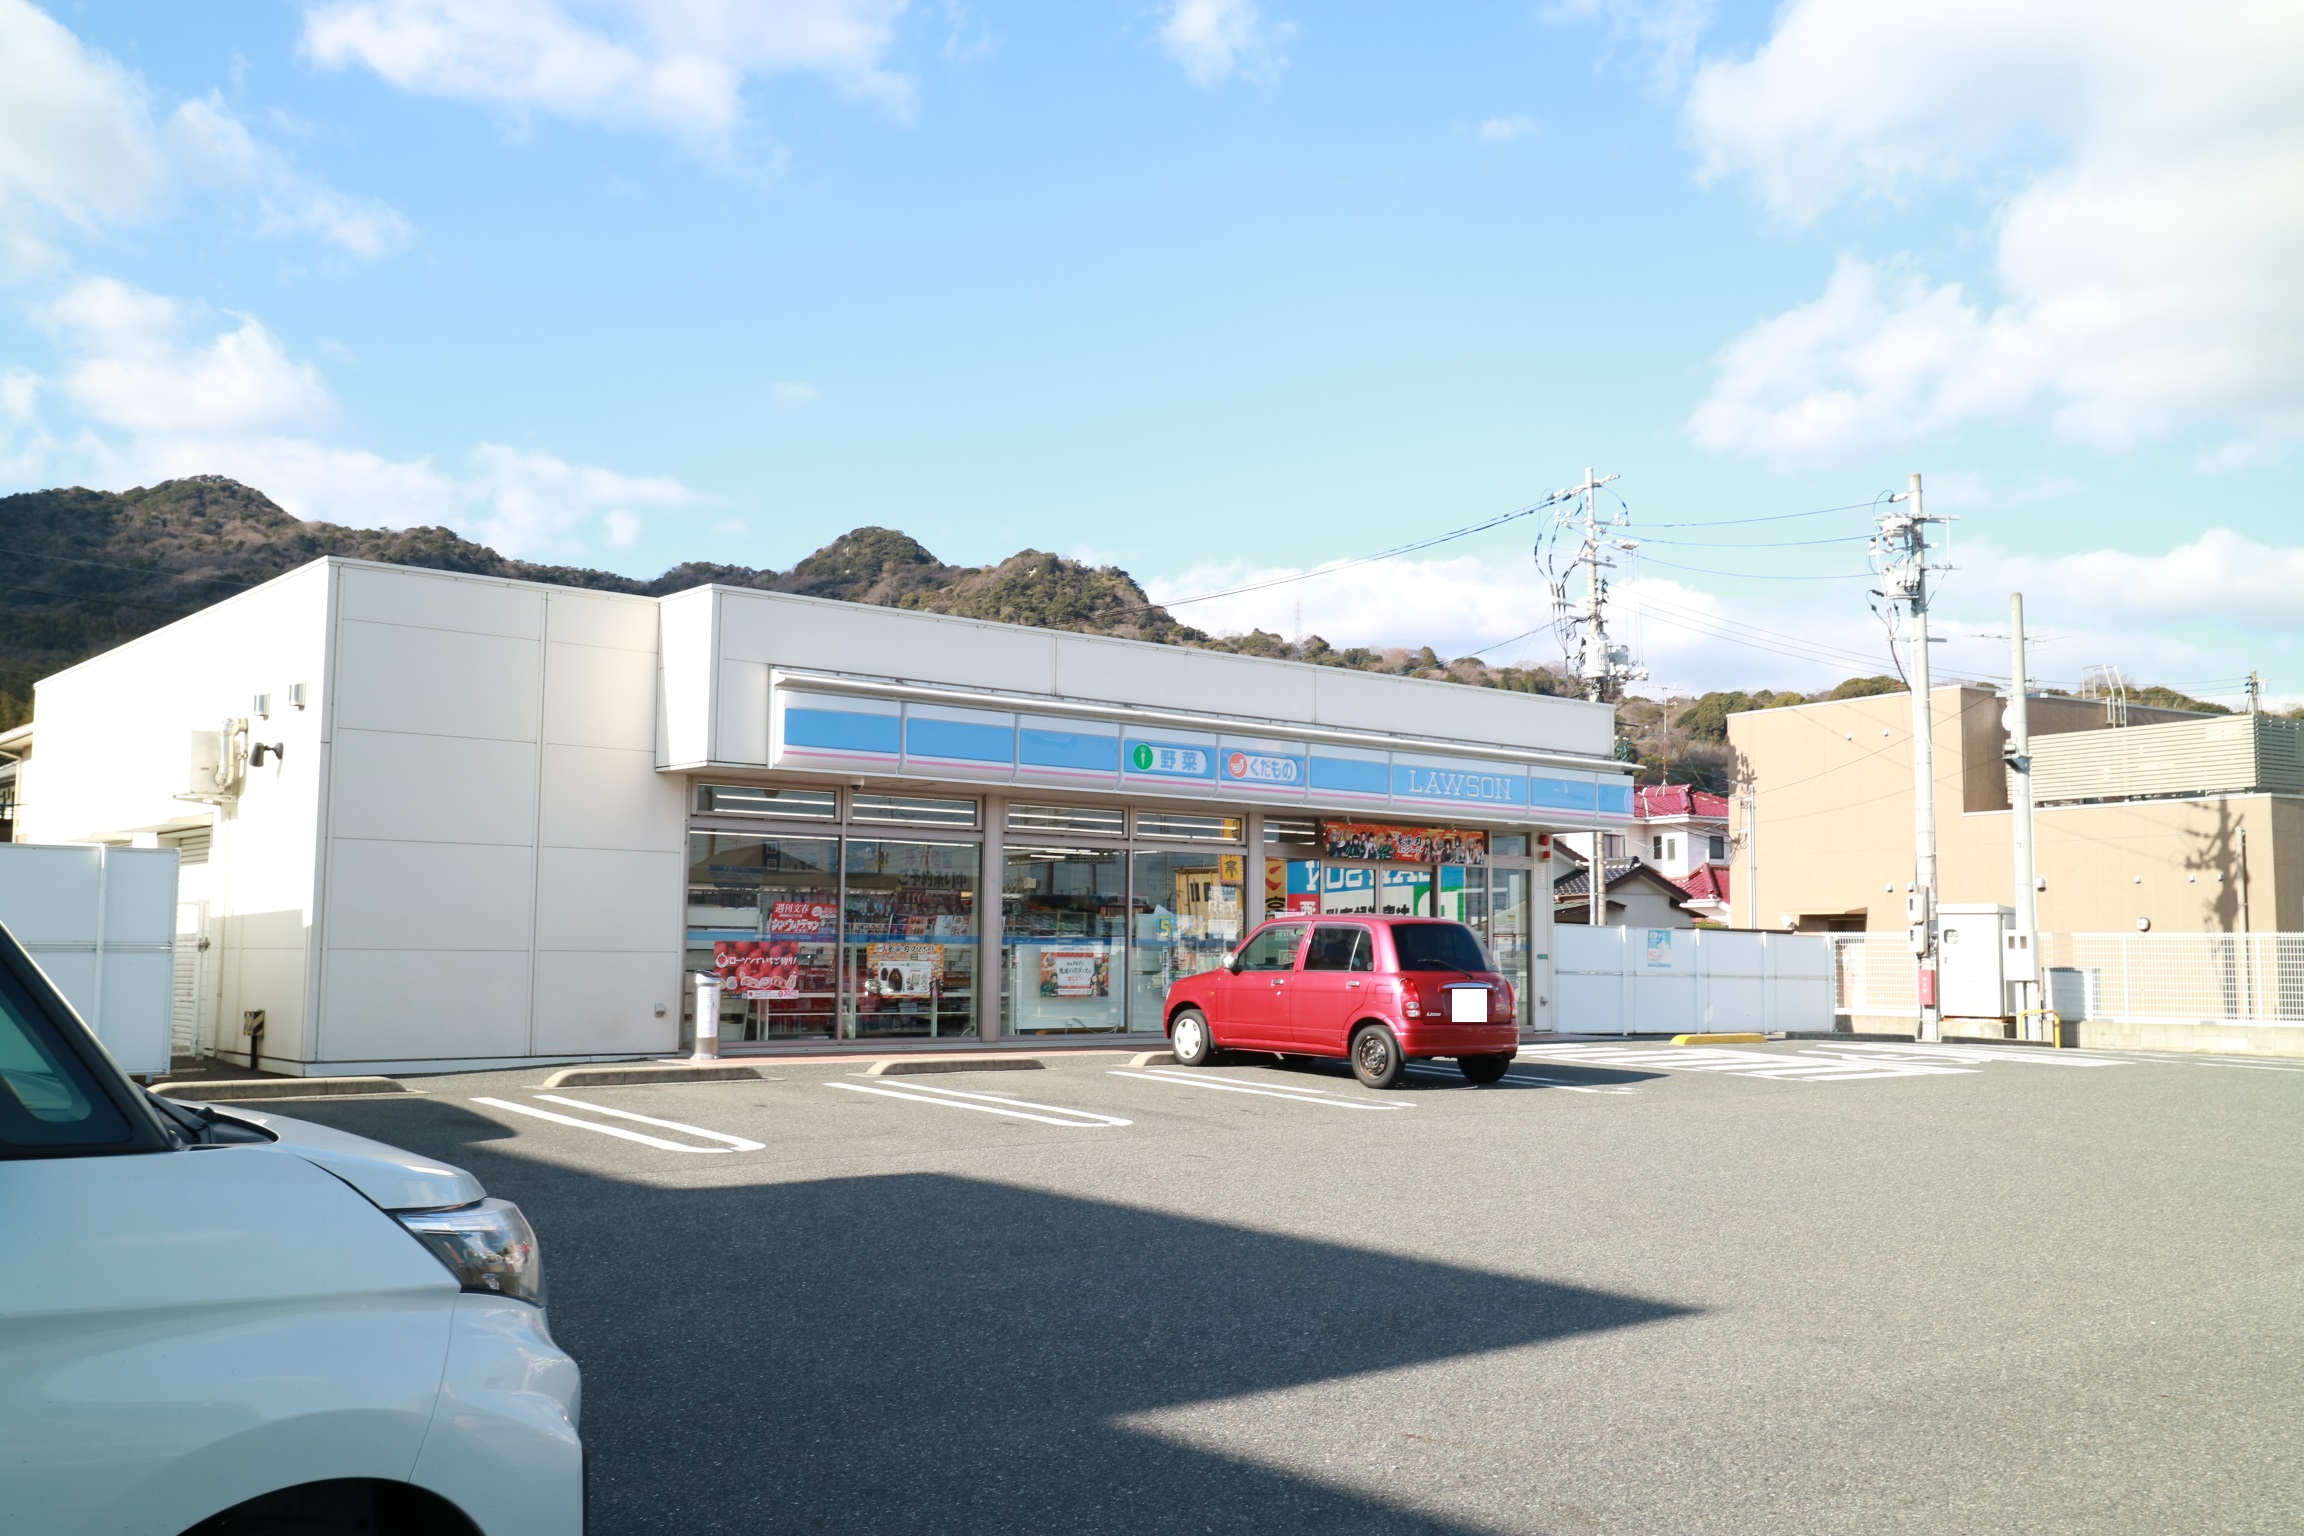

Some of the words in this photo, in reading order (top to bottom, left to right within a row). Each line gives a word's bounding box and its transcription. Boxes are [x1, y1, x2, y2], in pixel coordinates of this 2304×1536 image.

[1160, 749, 1197, 771] 野菜
[1249, 757, 1294, 780] くだもの
[1409, 769, 1512, 800] LAWSON
[775, 903, 810, 914] 週刊文春
